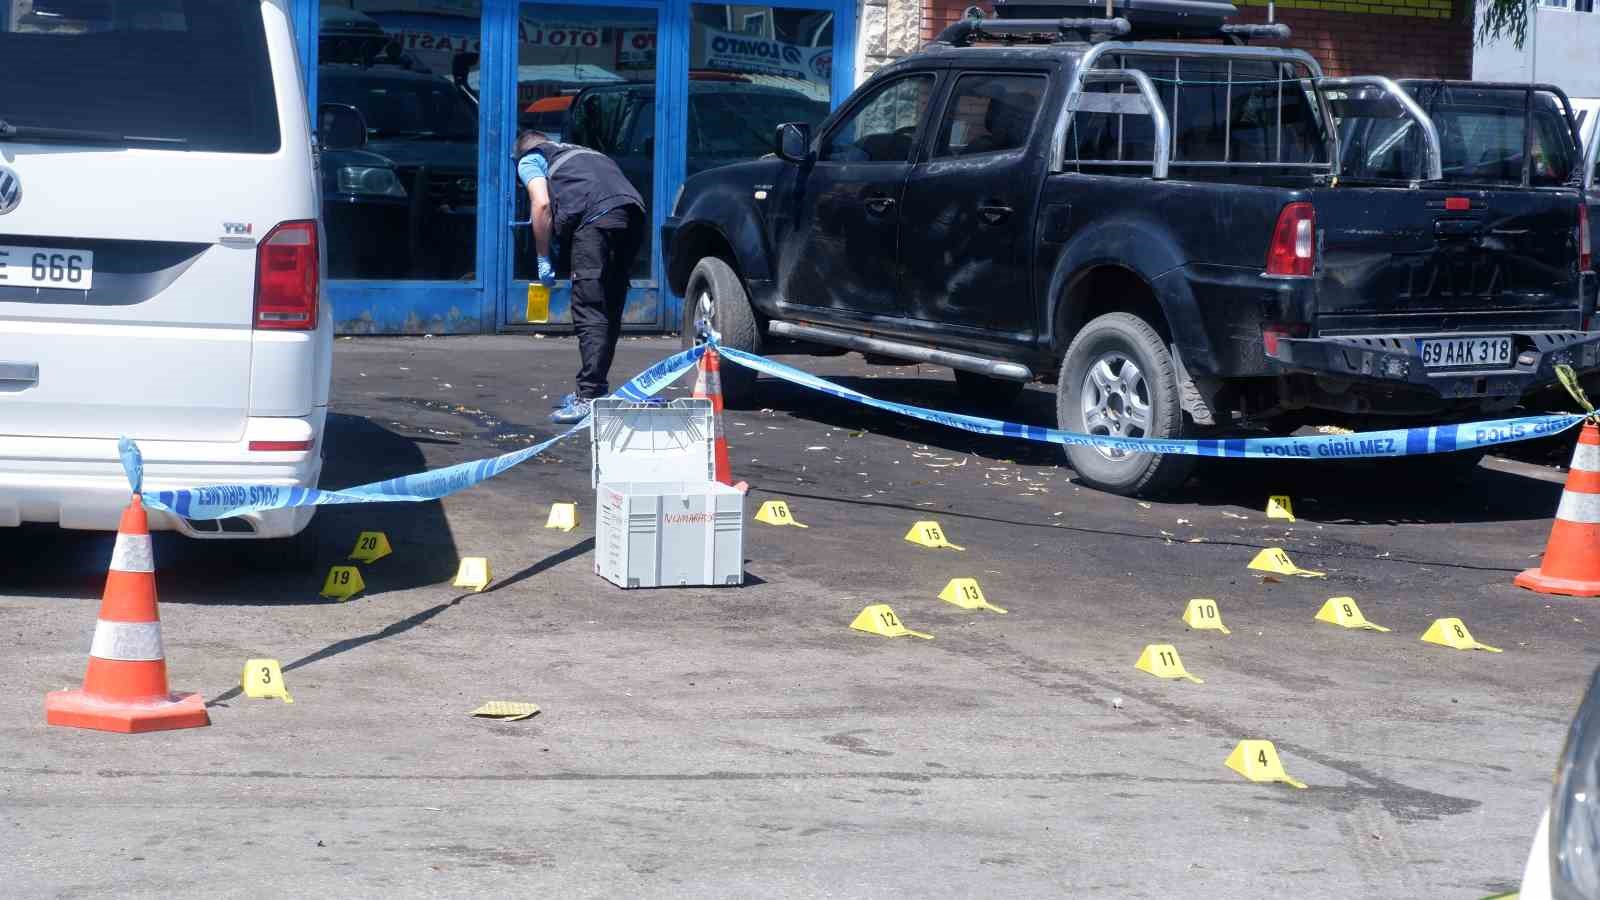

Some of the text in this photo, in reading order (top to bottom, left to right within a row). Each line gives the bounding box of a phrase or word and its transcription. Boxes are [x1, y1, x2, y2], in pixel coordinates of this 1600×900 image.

[32, 253, 82, 282] 666
[1422, 339, 1510, 363] 69 AAK 318
[1263, 438, 1396, 457] POLİS GİRİLMEZ
[772, 505, 785, 518] 16
[926, 528, 940, 541] 15
[361, 537, 376, 550] 20
[333, 570, 350, 585] 19
[963, 586, 978, 600] 13
[1198, 605, 1214, 618] 10
[1343, 604, 1353, 617] 9
[880, 612, 897, 626] 12
[1454, 624, 1465, 638] 8
[1160, 652, 1175, 666] 11
[261, 667, 270, 684] 3
[1258, 750, 1267, 767] 4
